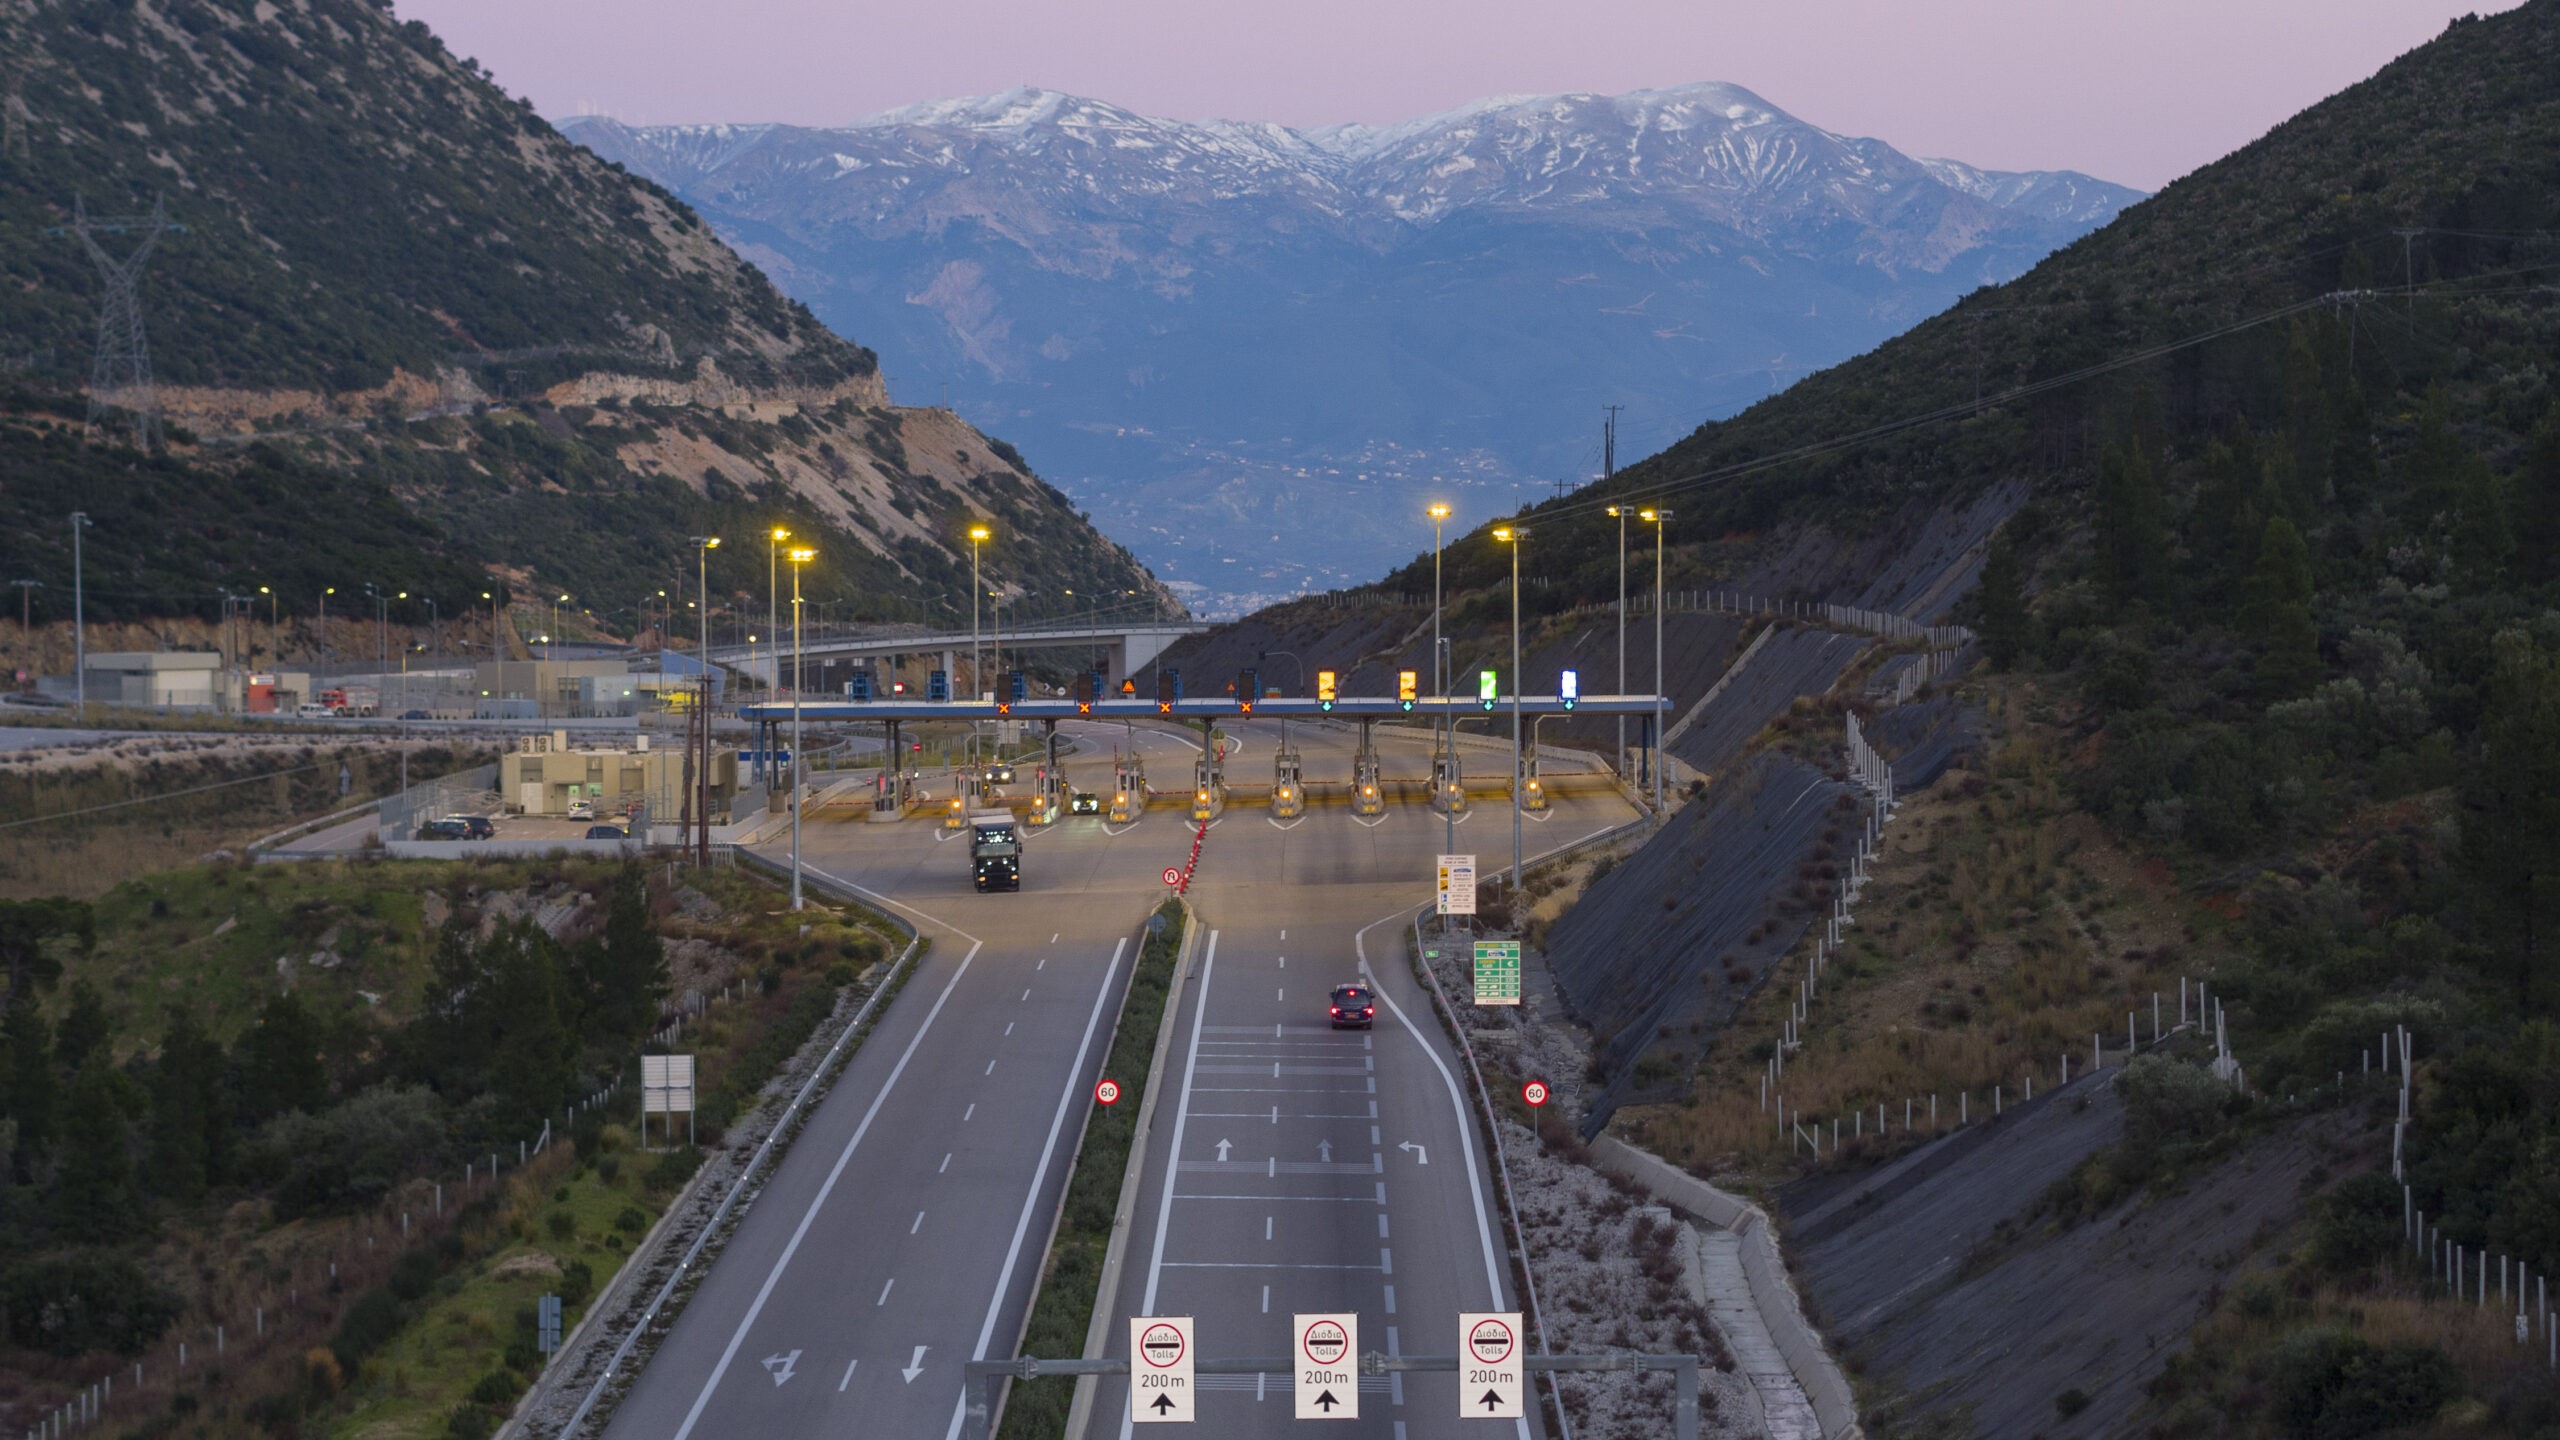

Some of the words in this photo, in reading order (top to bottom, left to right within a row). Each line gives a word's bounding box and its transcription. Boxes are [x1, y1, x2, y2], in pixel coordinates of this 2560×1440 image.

[1101, 1087, 1115, 1097] 60
[1528, 1088, 1542, 1098] 60
[1147, 1332, 1178, 1342] Διόδια
[1310, 1329, 1342, 1339] Διόδια
[1475, 1328, 1507, 1338] Διόδια
[1151, 1350, 1174, 1359] Tolls
[1315, 1346, 1338, 1356] Tolls
[1480, 1345, 1503, 1355] Tolls
[1141, 1374, 1168, 1388] 200
[1171, 1377, 1185, 1388] m
[1305, 1370, 1332, 1384] 200
[1335, 1373, 1348, 1384] m
[1470, 1369, 1497, 1383] 200
[1499, 1373, 1513, 1383] m
